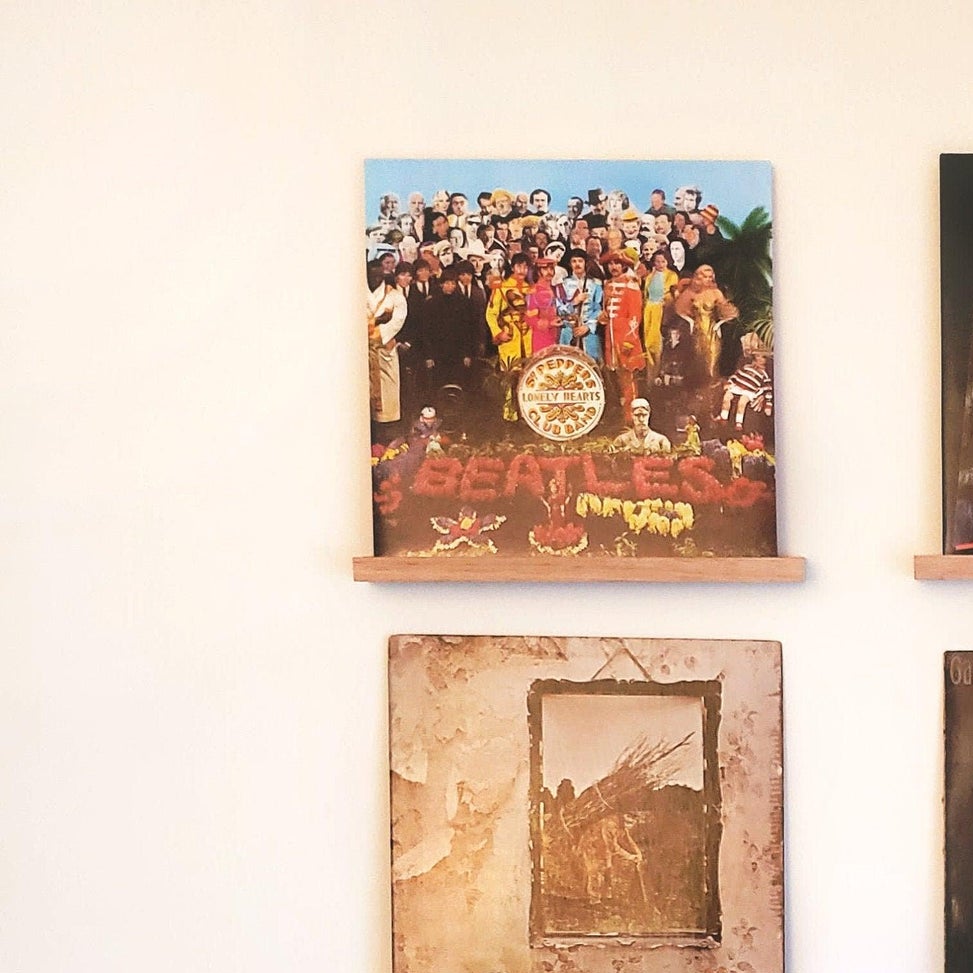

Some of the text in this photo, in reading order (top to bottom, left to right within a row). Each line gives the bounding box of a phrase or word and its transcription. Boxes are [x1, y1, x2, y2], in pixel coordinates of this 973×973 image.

[522, 391, 600, 402] LONELY HEARTS
[410, 454, 724, 505] BEATLES
